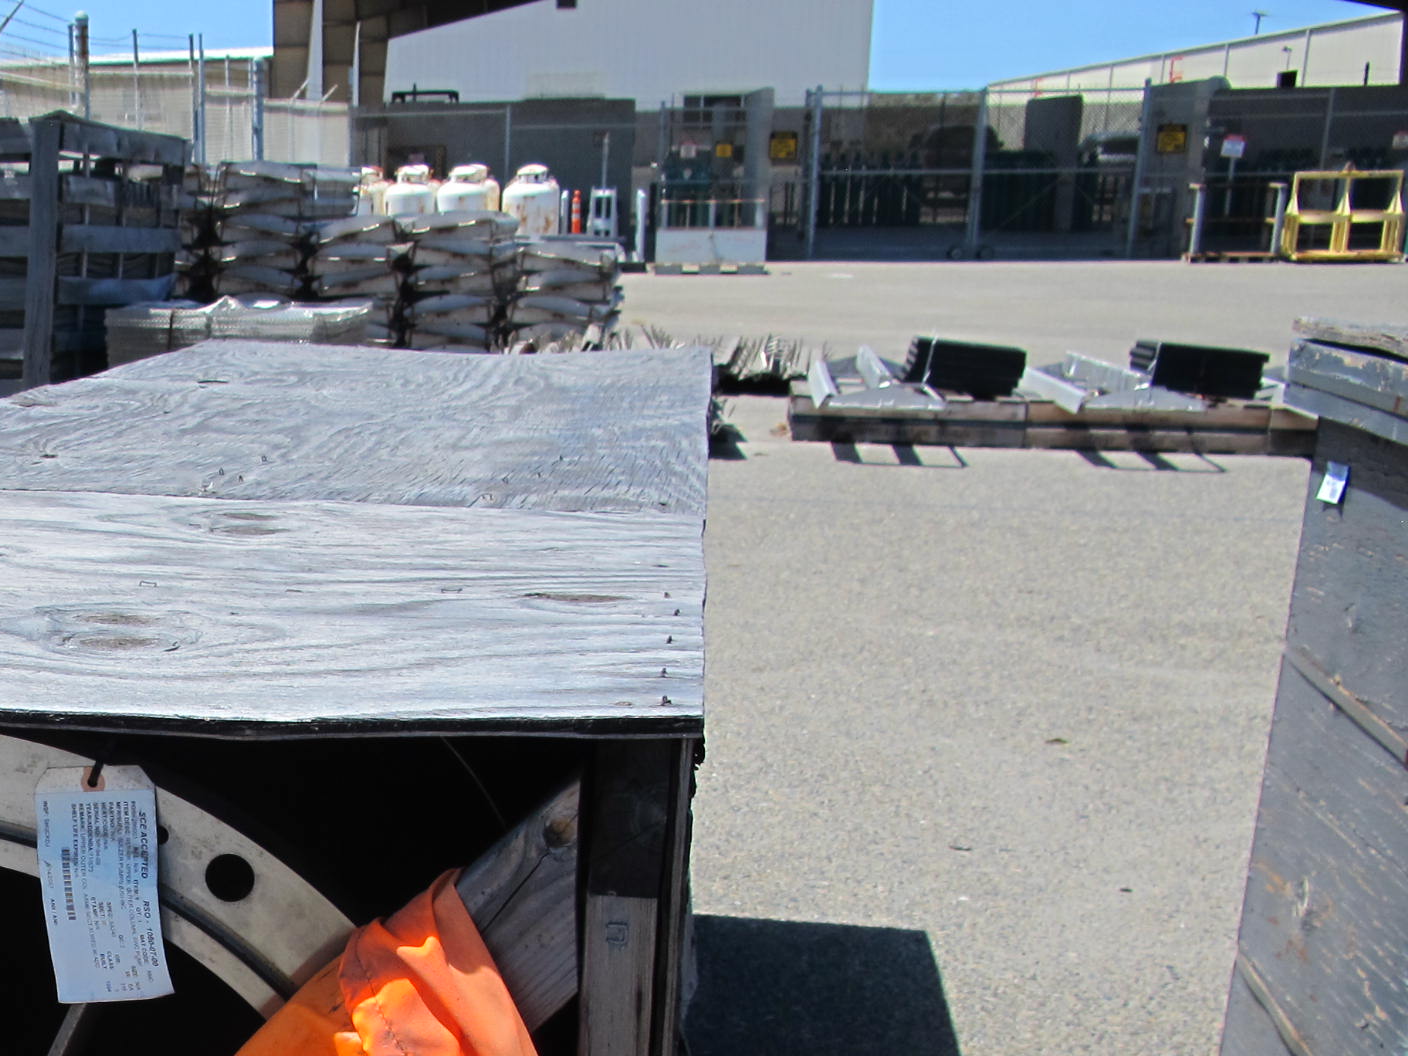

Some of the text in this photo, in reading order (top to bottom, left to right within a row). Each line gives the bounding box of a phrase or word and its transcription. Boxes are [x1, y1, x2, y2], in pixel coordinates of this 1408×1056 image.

[138, 810, 147, 830] SCE
[137, 831, 151, 878] ACCEPTED
[143, 900, 151, 918] RSO
